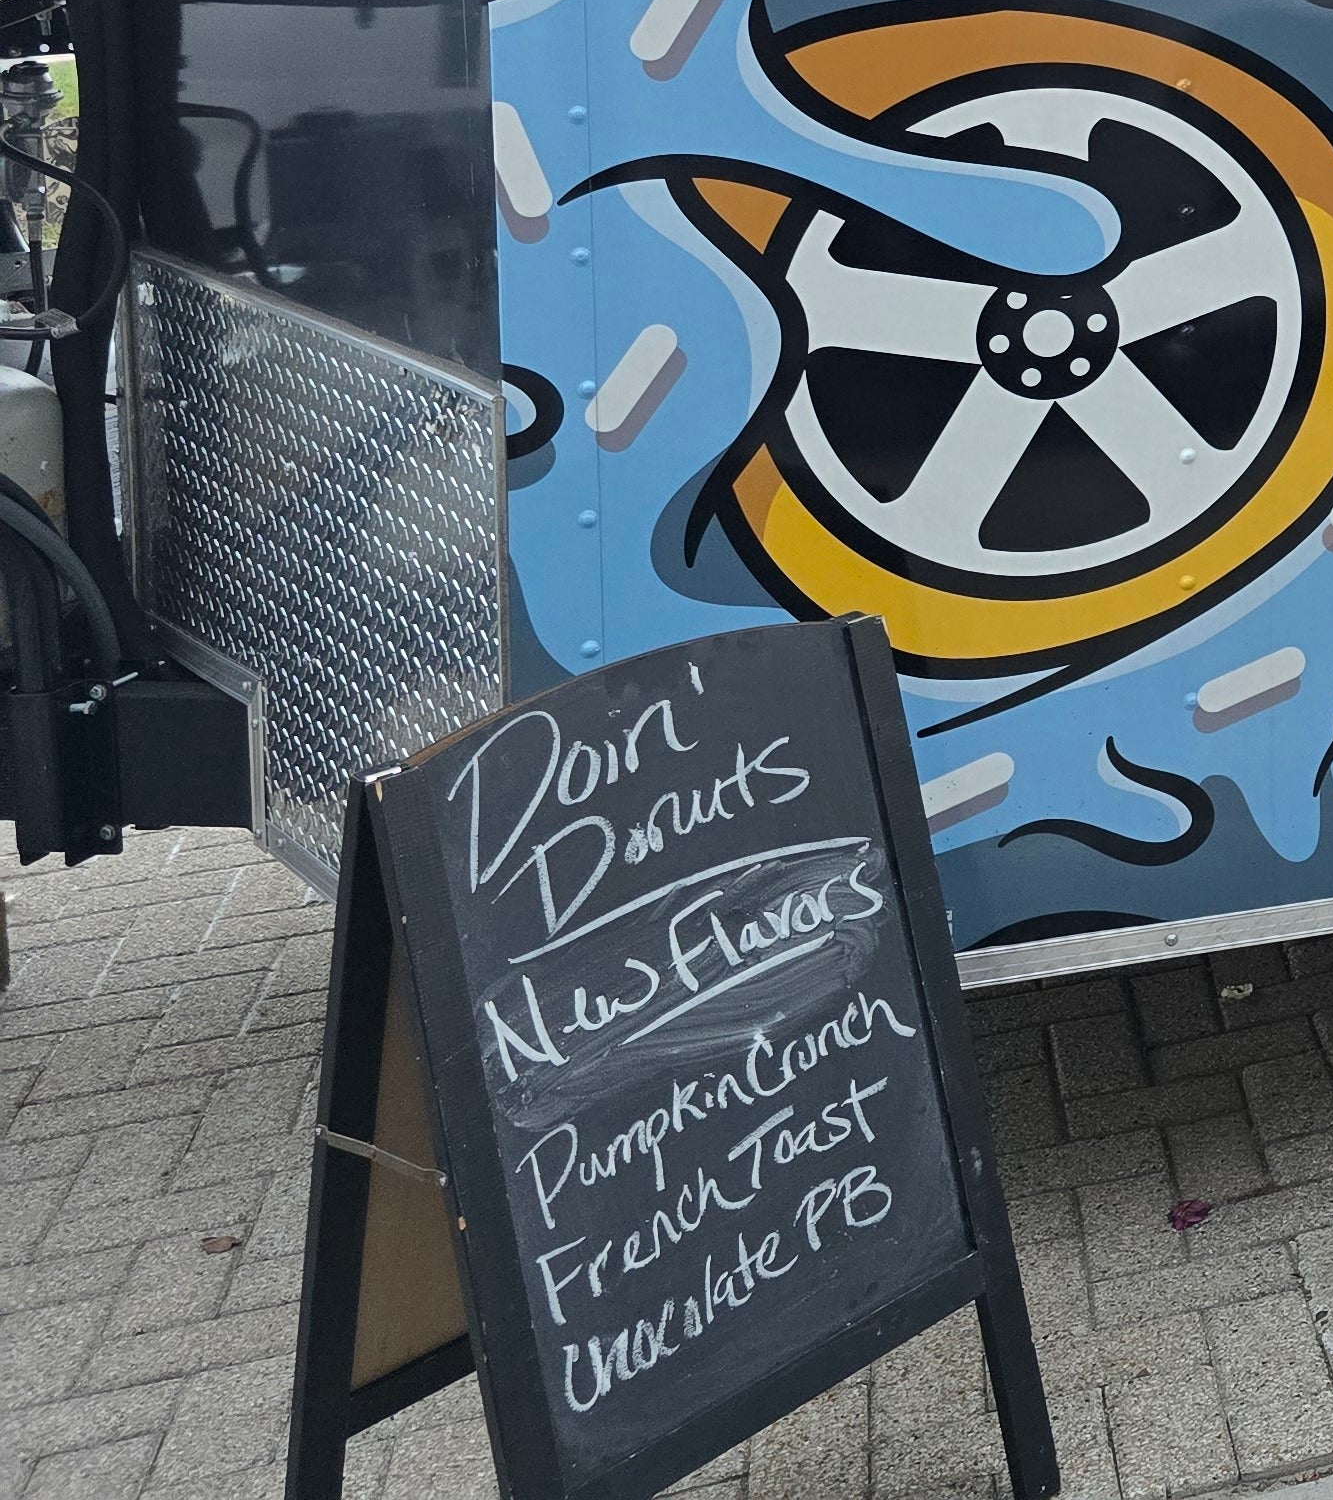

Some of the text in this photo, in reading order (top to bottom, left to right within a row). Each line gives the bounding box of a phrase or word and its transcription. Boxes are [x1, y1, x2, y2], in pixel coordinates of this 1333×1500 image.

[448, 661, 704, 894] Doin'
[492, 736, 810, 939] Donuts
[485, 861, 884, 1081] New Flavors
[515, 992, 916, 1229] Pumpkin Crunch
[536, 1076, 889, 1325] French Toast
[794, 1165, 892, 1252] PB
